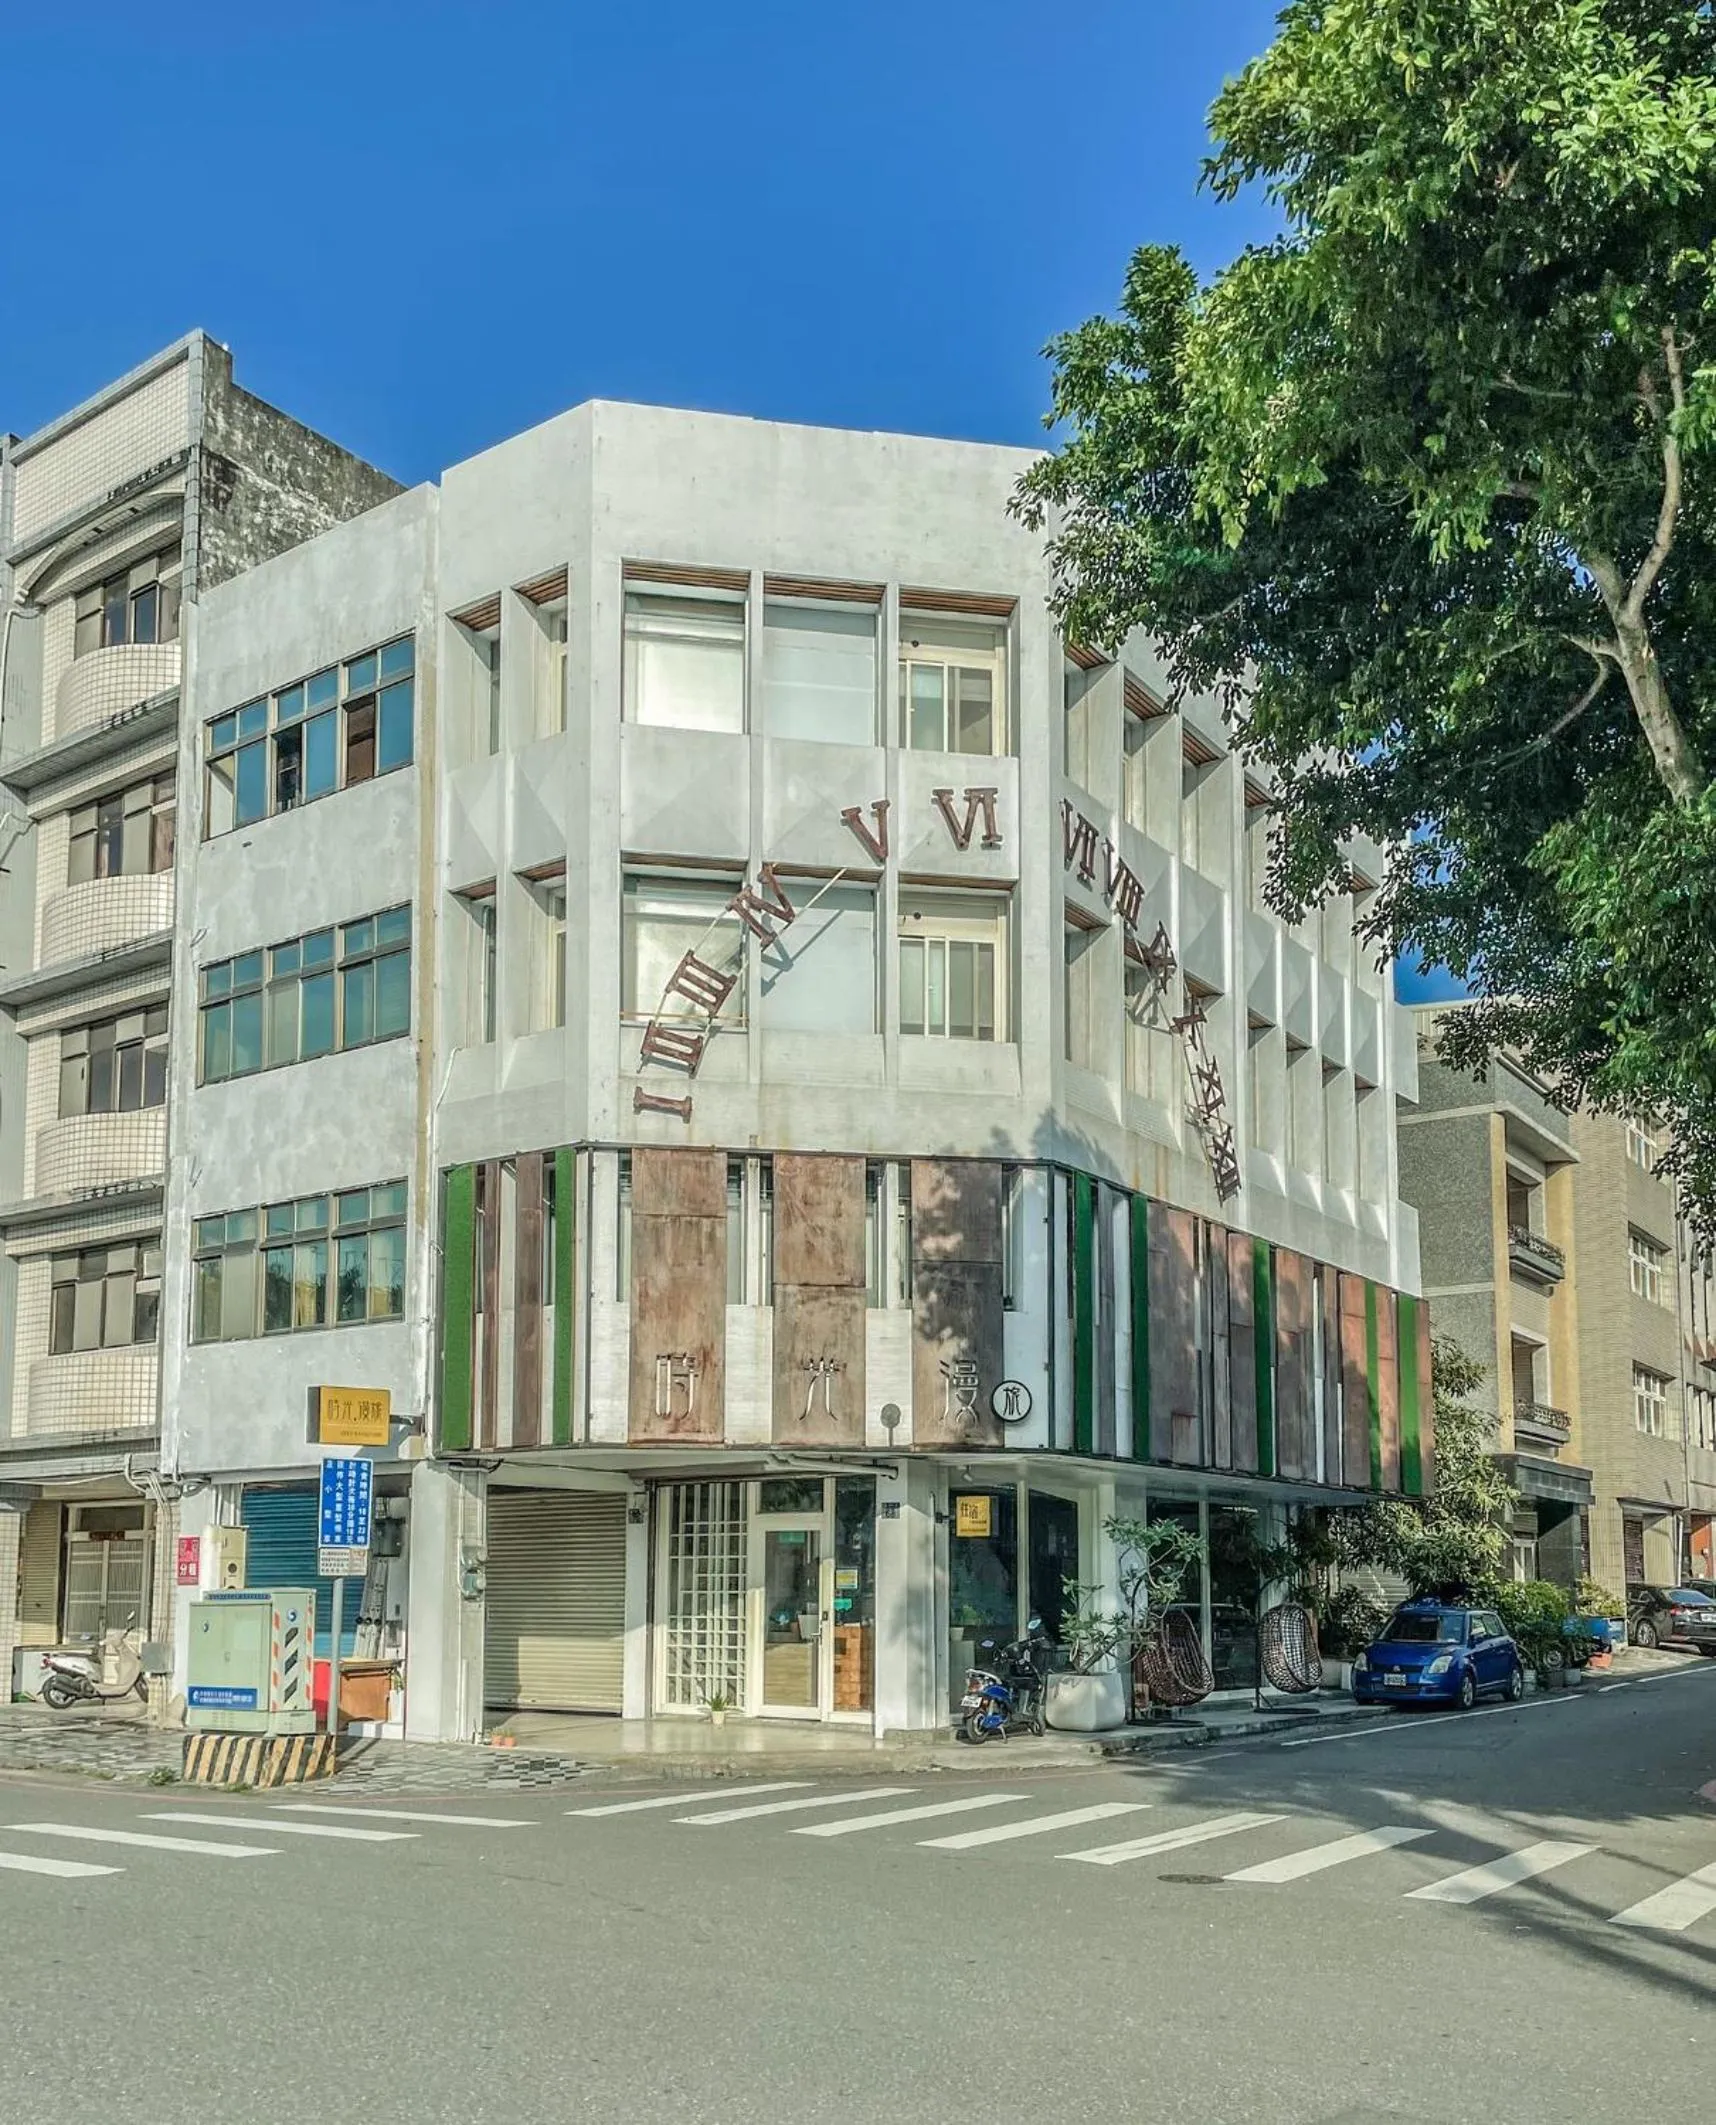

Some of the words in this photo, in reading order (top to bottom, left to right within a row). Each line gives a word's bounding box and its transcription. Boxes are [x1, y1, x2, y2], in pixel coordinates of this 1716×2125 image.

[841, 800, 890, 858] V
[932, 787, 1002, 843] VI
[1061, 798, 1099, 880] VII
[726, 862, 796, 952] IV
[1101, 837, 1145, 931] VIII
[665, 949, 737, 1018] III
[633, 1086, 692, 1124] I
